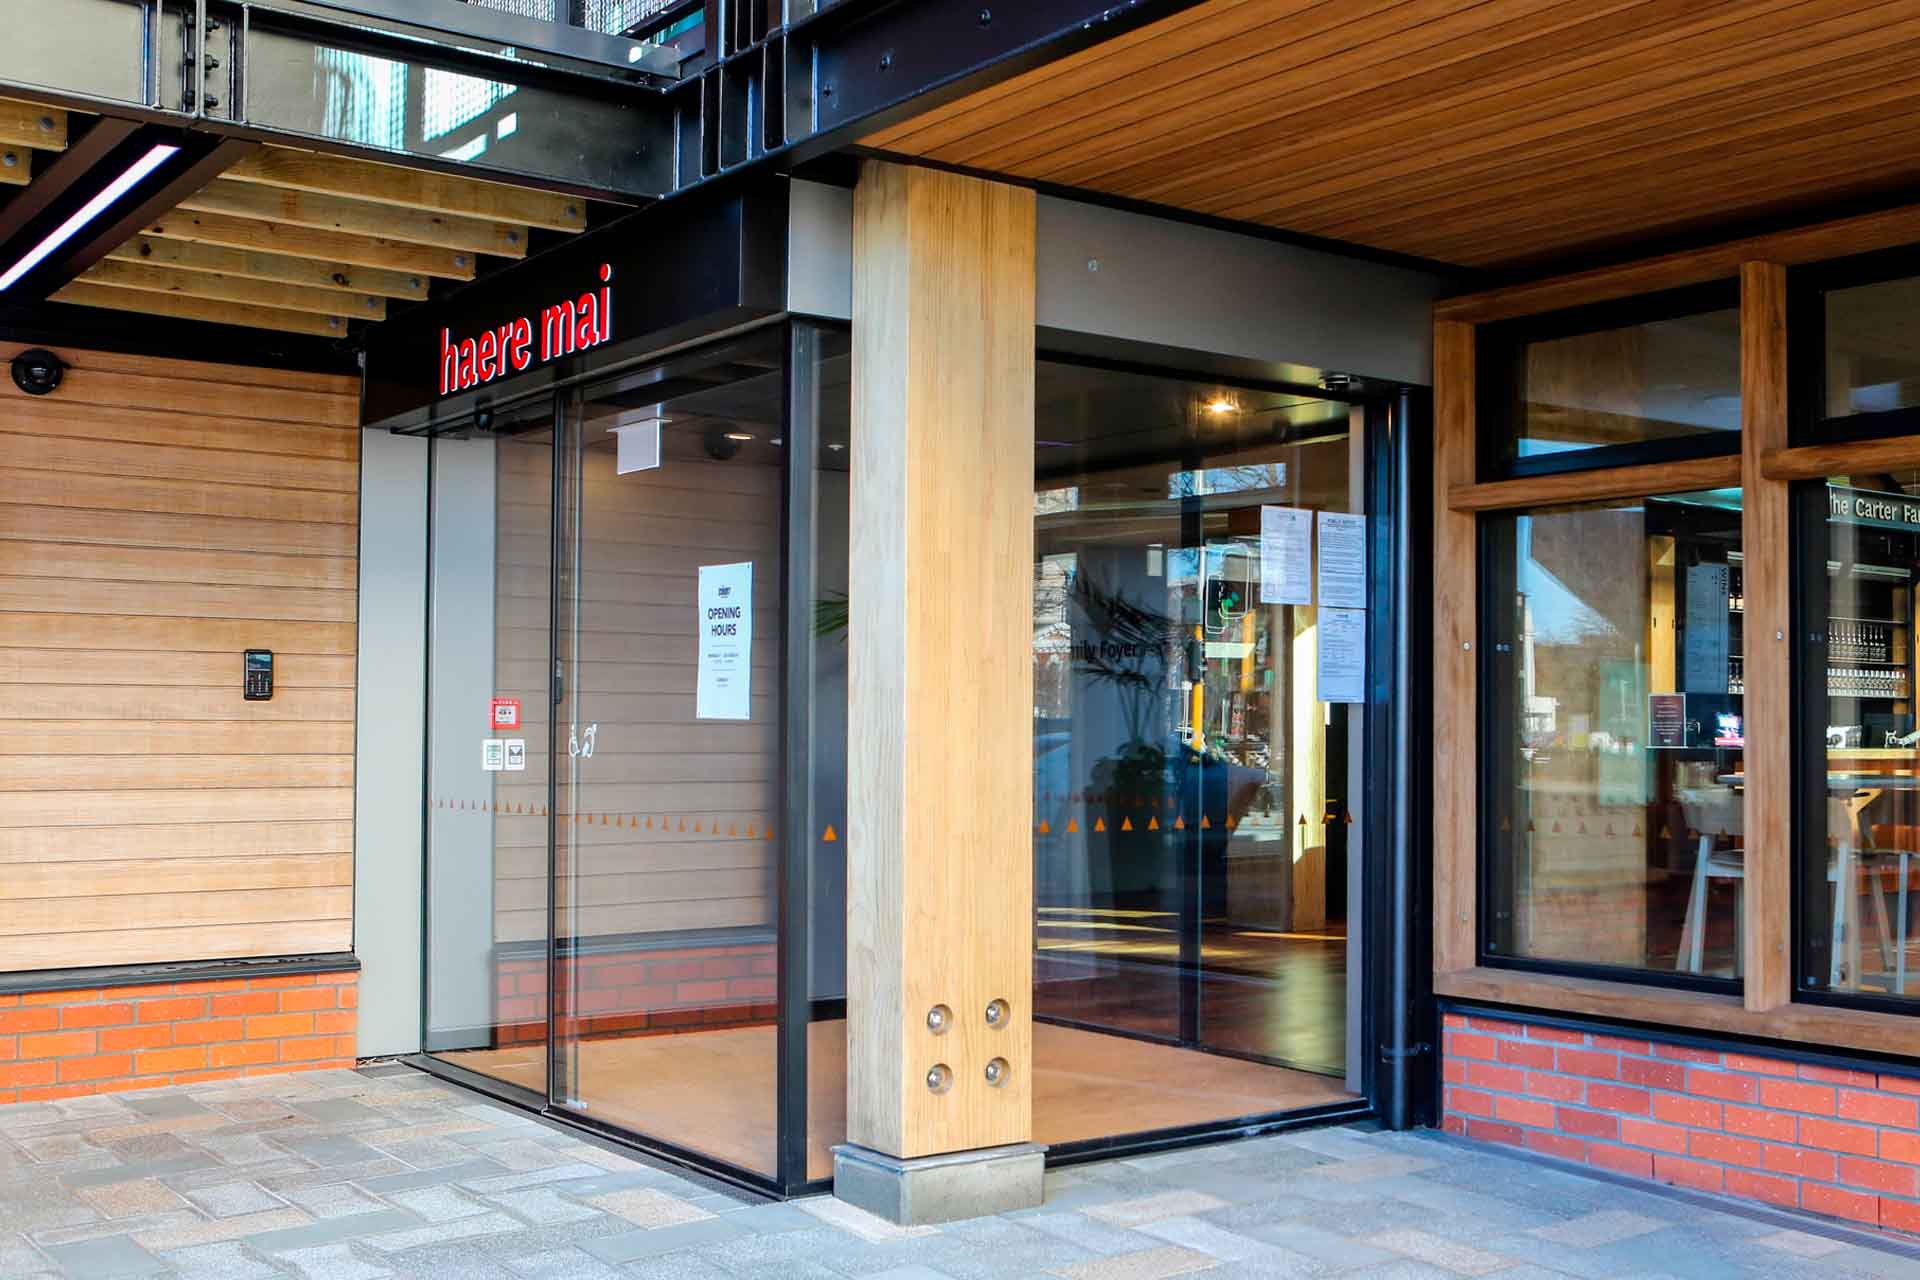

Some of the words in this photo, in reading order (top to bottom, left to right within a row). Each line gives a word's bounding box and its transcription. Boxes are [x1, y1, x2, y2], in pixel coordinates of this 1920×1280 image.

[439, 317, 532, 395] haere
[540, 262, 612, 362] mai
[1855, 498, 1898, 521] Carter
[1903, 504, 1920, 525] Fa
[707, 606, 741, 620] OPENING
[711, 623, 737, 637] HOURS
[1100, 640, 1136, 663] Foyer
